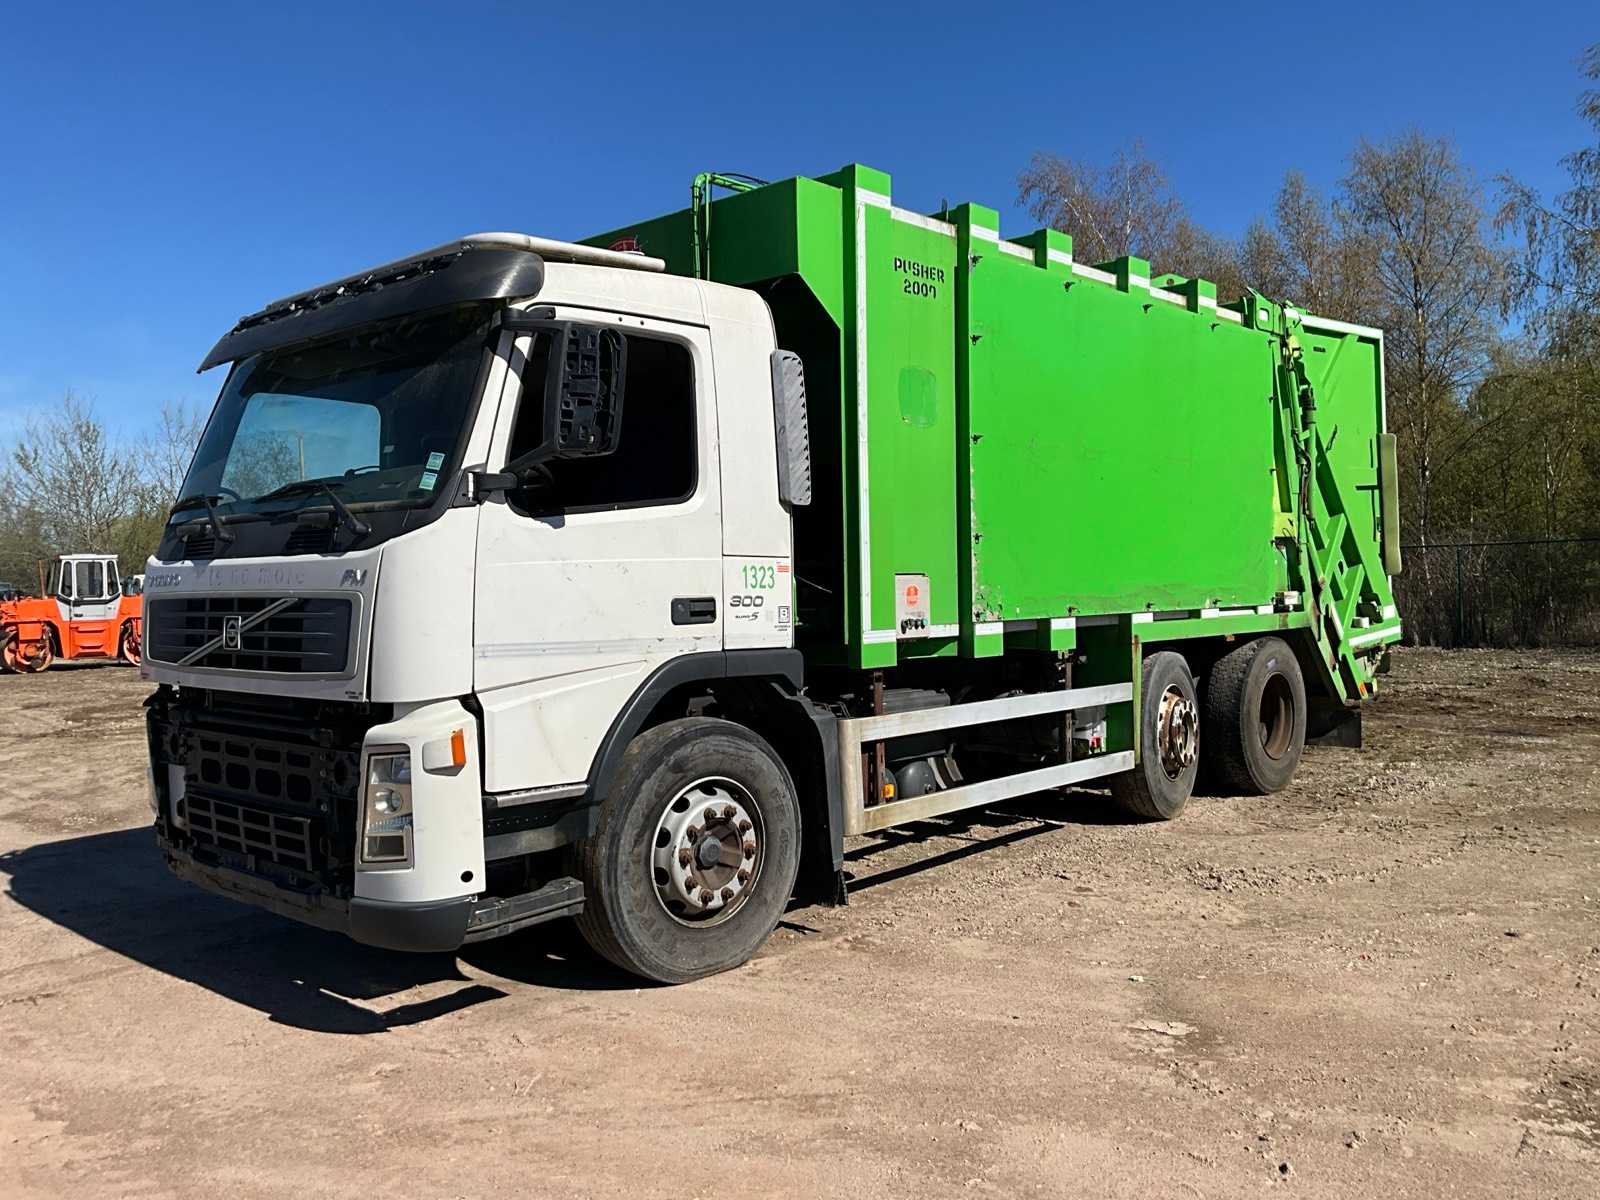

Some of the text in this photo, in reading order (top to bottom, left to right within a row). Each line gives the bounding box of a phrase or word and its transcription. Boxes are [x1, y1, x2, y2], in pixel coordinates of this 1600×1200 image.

[894, 257, 945, 284] PUSHER
[742, 565, 776, 589] 1323
[730, 595, 764, 607] 300
